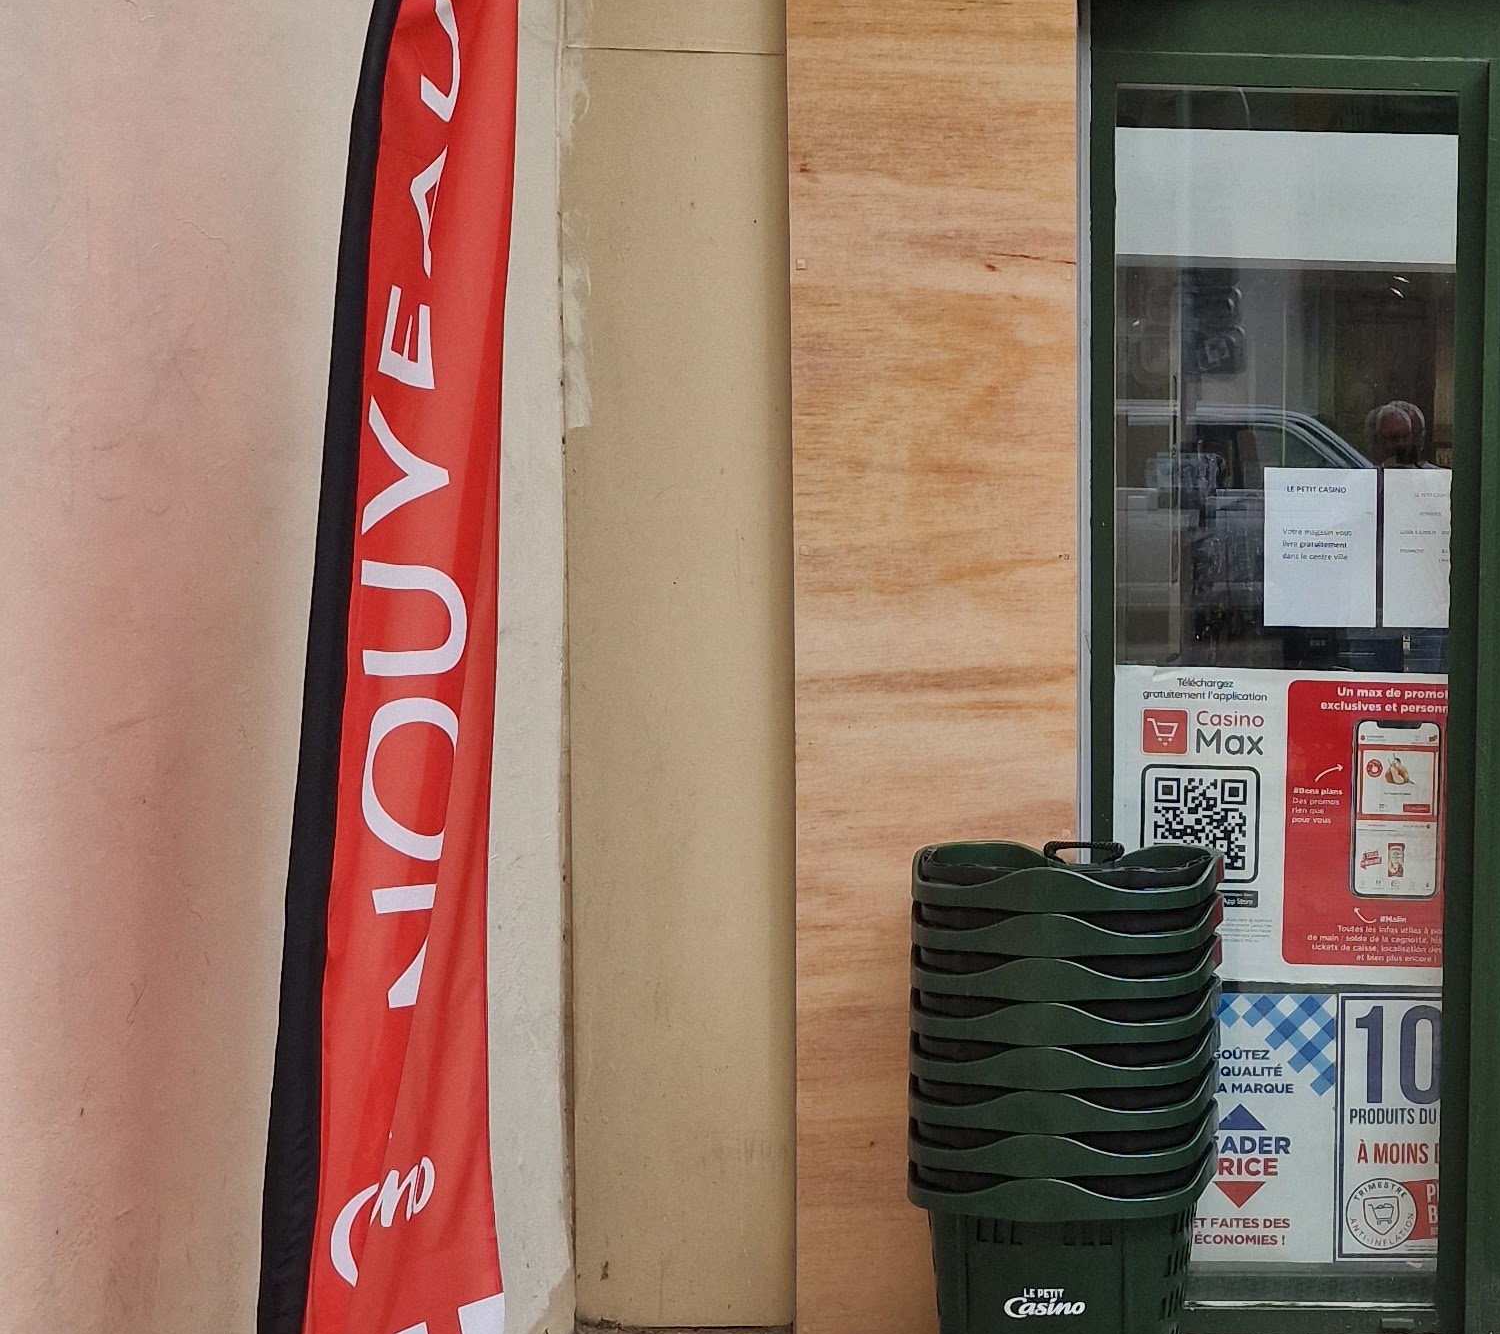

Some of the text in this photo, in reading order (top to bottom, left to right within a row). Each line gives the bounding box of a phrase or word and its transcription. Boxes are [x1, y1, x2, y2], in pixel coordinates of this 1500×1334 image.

[1286, 486, 1347, 494] LE PETIT CASINO
[1177, 677, 1234, 689] Téléchargez
[1142, 690, 1268, 702] gratuitement l'application
[1337, 686, 1354, 697] Un
[1357, 689, 1383, 698] max
[1385, 687, 1401, 698] de
[1320, 701, 1448, 714] exclusives et personn
[1196, 710, 1265, 728] Casino
[1195, 728, 1264, 755] Max
[1309, 798, 1340, 807] promos
[1338, 924, 1363, 933] Toutes
[1220, 1063, 1283, 1077] QUALITÉ
[1231, 1083, 1294, 1094] MARQUE
[1350, 1107, 1437, 1125] PRODUITS DU
[1214, 1135, 1291, 1155] ADER
[1357, 1138, 1369, 1164] À
[1373, 1142, 1429, 1164] MOINS
[1218, 1157, 1279, 1177] RICE
[1353, 1181, 1408, 1201] TRIMESTRE
[1210, 1218, 1260, 1229] FAITES
[1262, 1218, 1291, 1229] DES
[1350, 1212, 1414, 1247] ANTI-INFLATION
[1194, 1231, 1278, 1246] ÉCONOMIES
[1023, 1288, 1065, 1299] LE PETIT
[1003, 1297, 1085, 1318] Casino
